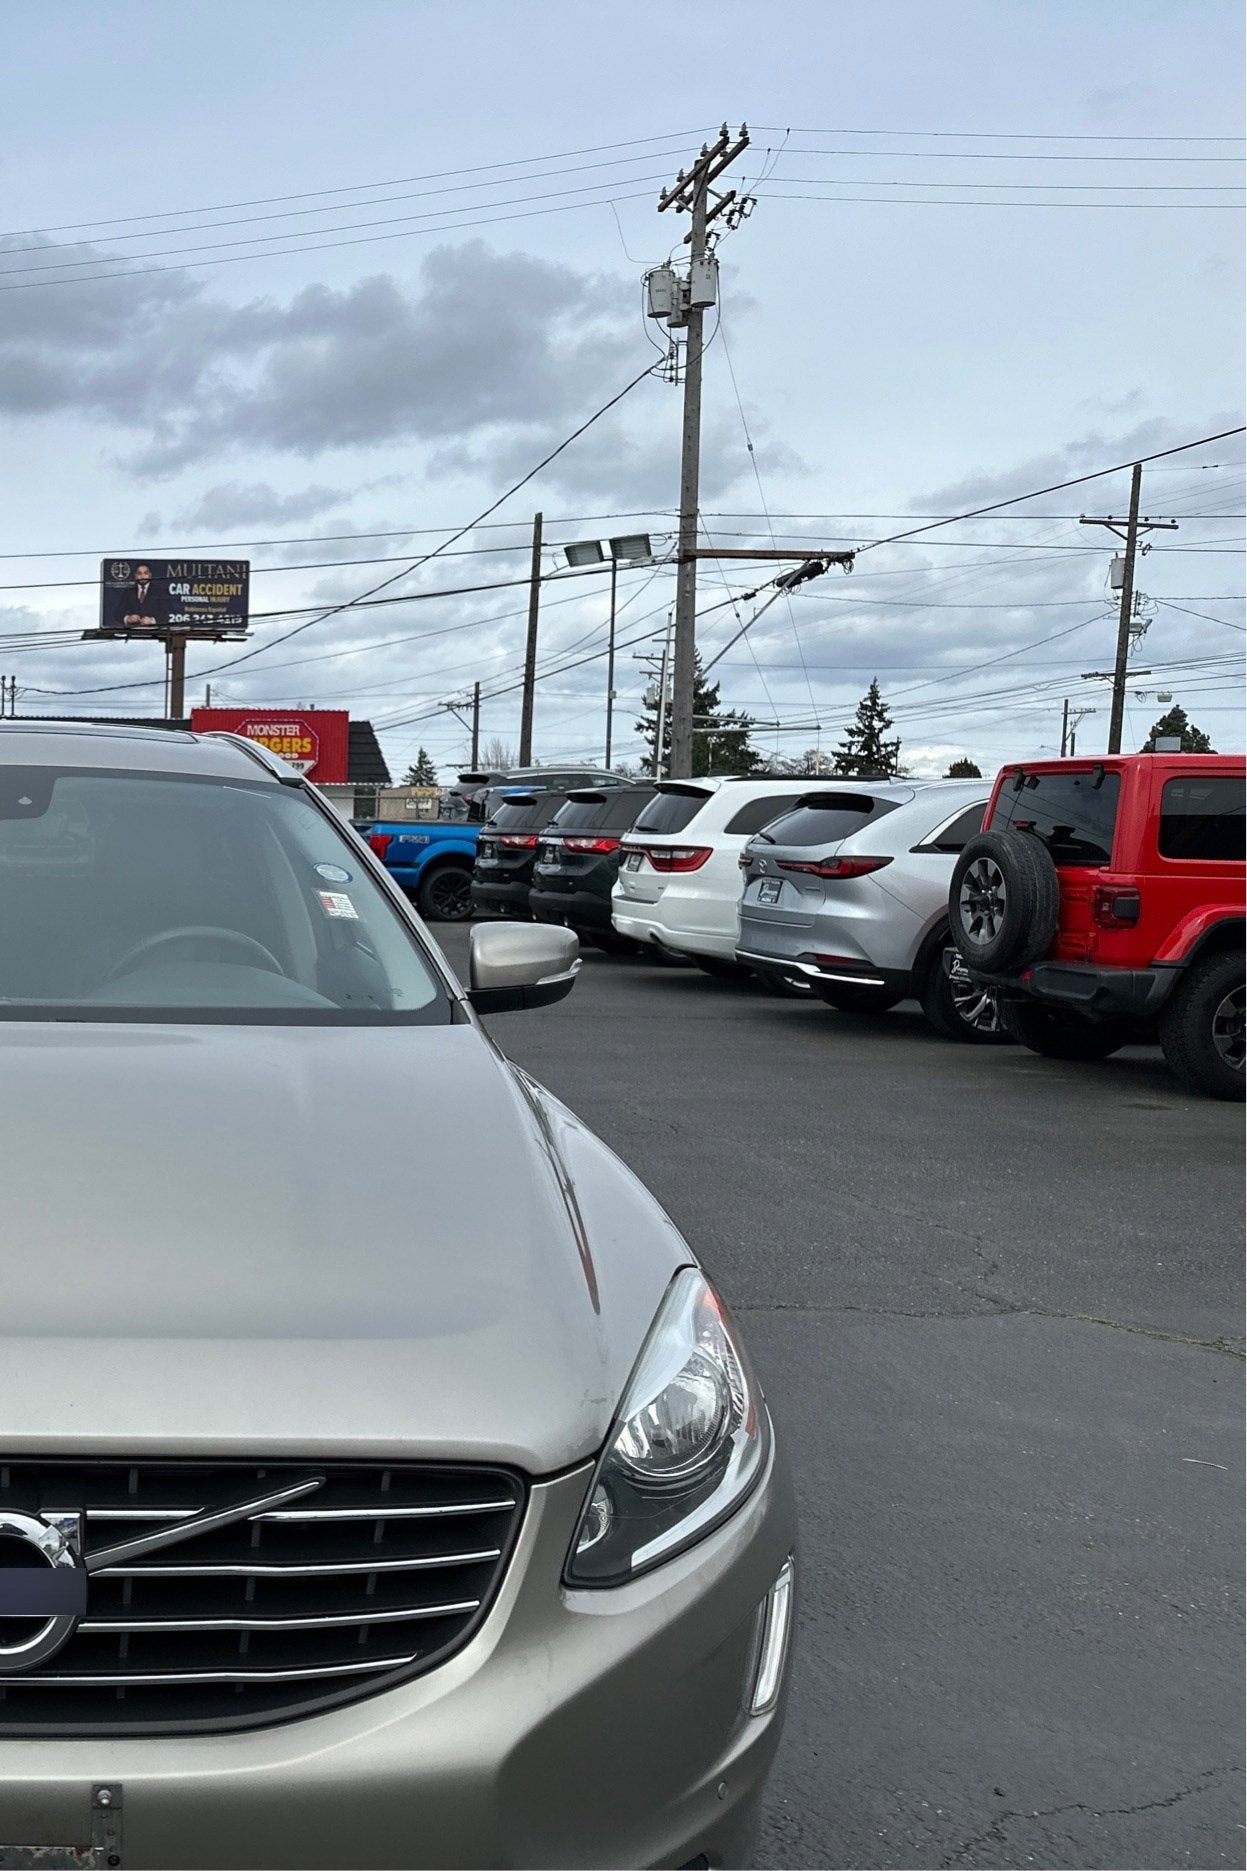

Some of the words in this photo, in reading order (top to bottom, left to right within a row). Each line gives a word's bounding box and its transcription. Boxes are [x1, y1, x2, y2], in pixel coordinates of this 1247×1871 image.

[166, 564, 247, 579] MULTANI
[169, 583, 190, 595] CAR
[192, 583, 243, 596] ACCIDENT
[181, 595, 209, 603] PERSONAL
[246, 724, 300, 736] MONSTER
[256, 736, 312, 753] RGERS
